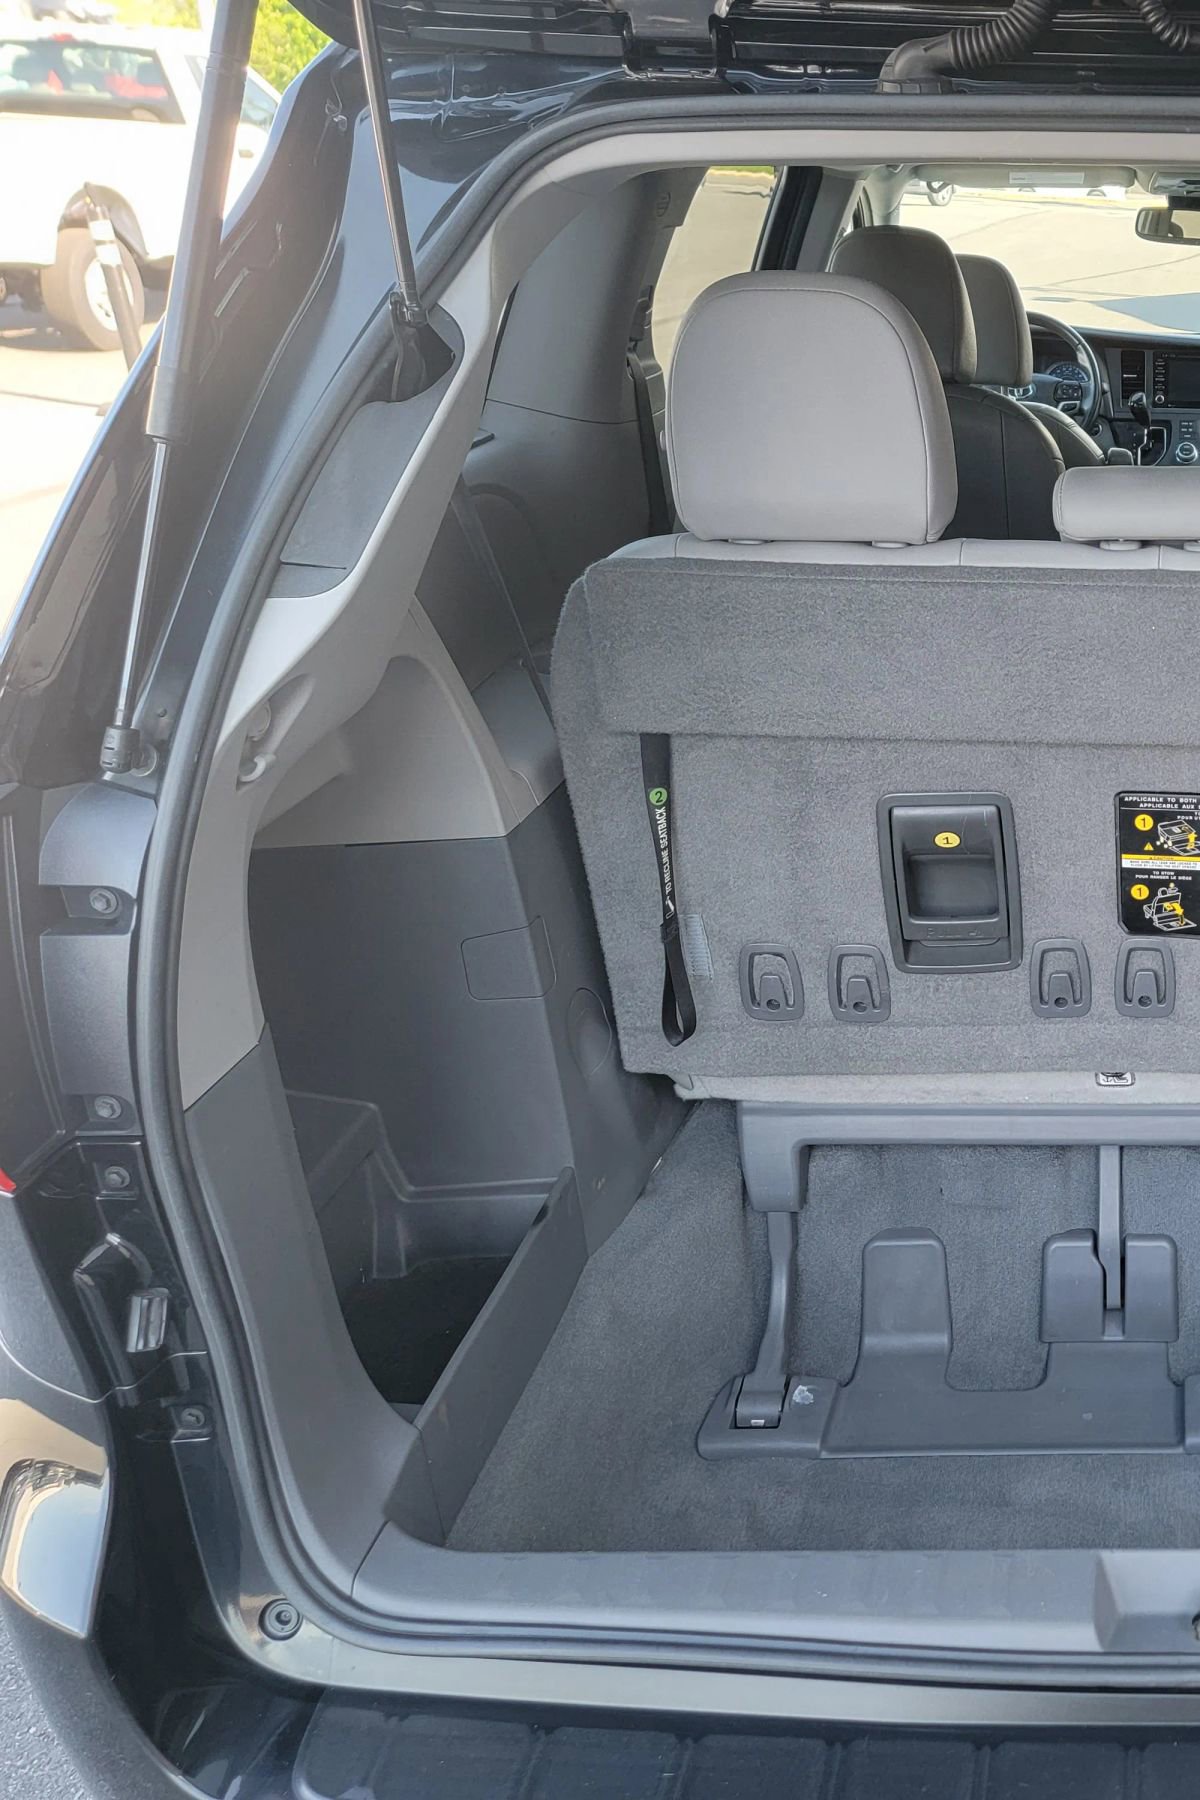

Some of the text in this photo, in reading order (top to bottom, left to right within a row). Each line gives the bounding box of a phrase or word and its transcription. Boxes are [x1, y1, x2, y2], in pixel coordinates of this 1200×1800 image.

[655, 790, 663, 804] 2
[655, 806, 668, 848] SEATBACK
[942, 836, 953, 845] 1
[665, 882, 673, 895] TO
